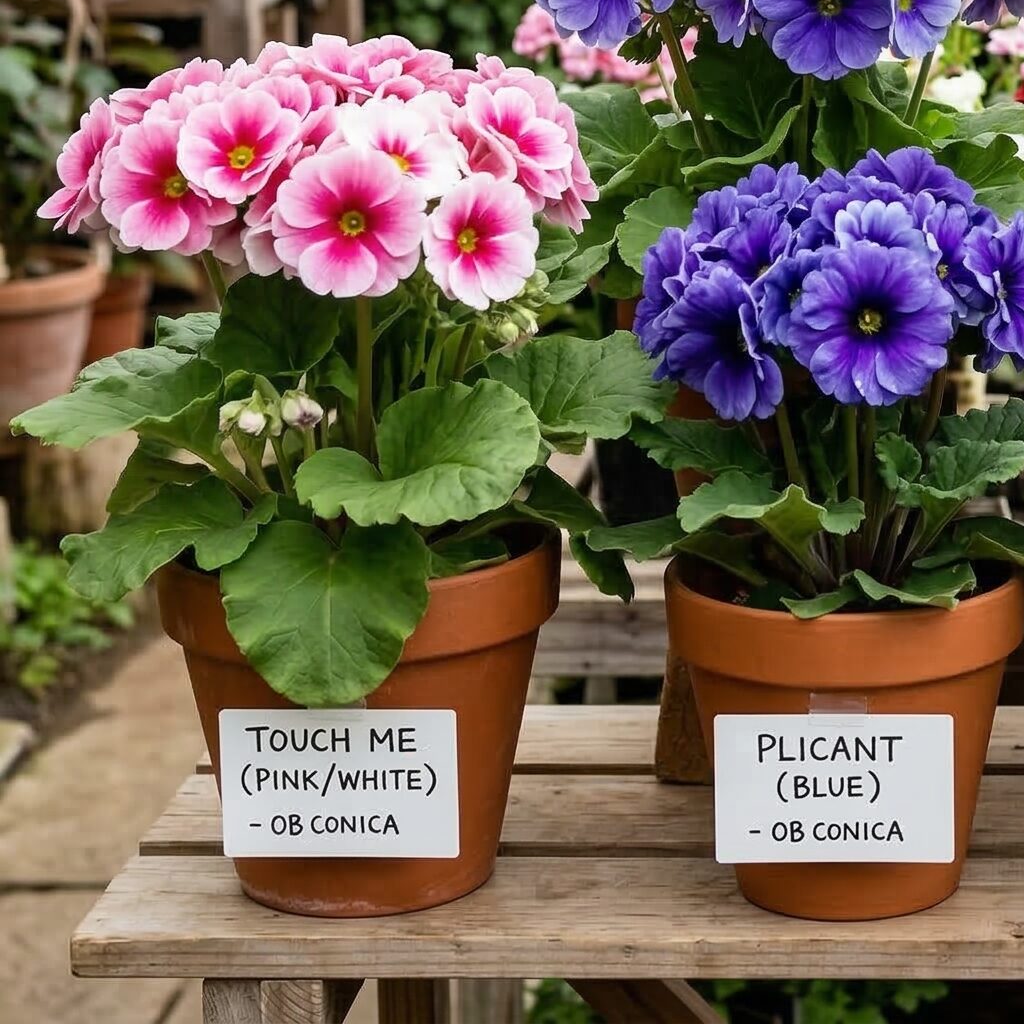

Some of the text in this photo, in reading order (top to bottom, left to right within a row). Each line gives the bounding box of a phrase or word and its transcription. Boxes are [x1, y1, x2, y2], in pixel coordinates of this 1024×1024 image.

[244, 725, 417, 753] TOUCH ME
[757, 733, 903, 764] PLICANT
[240, 762, 437, 798] (PINK/WHITE)
[776, 770, 881, 804] (BLUE)
